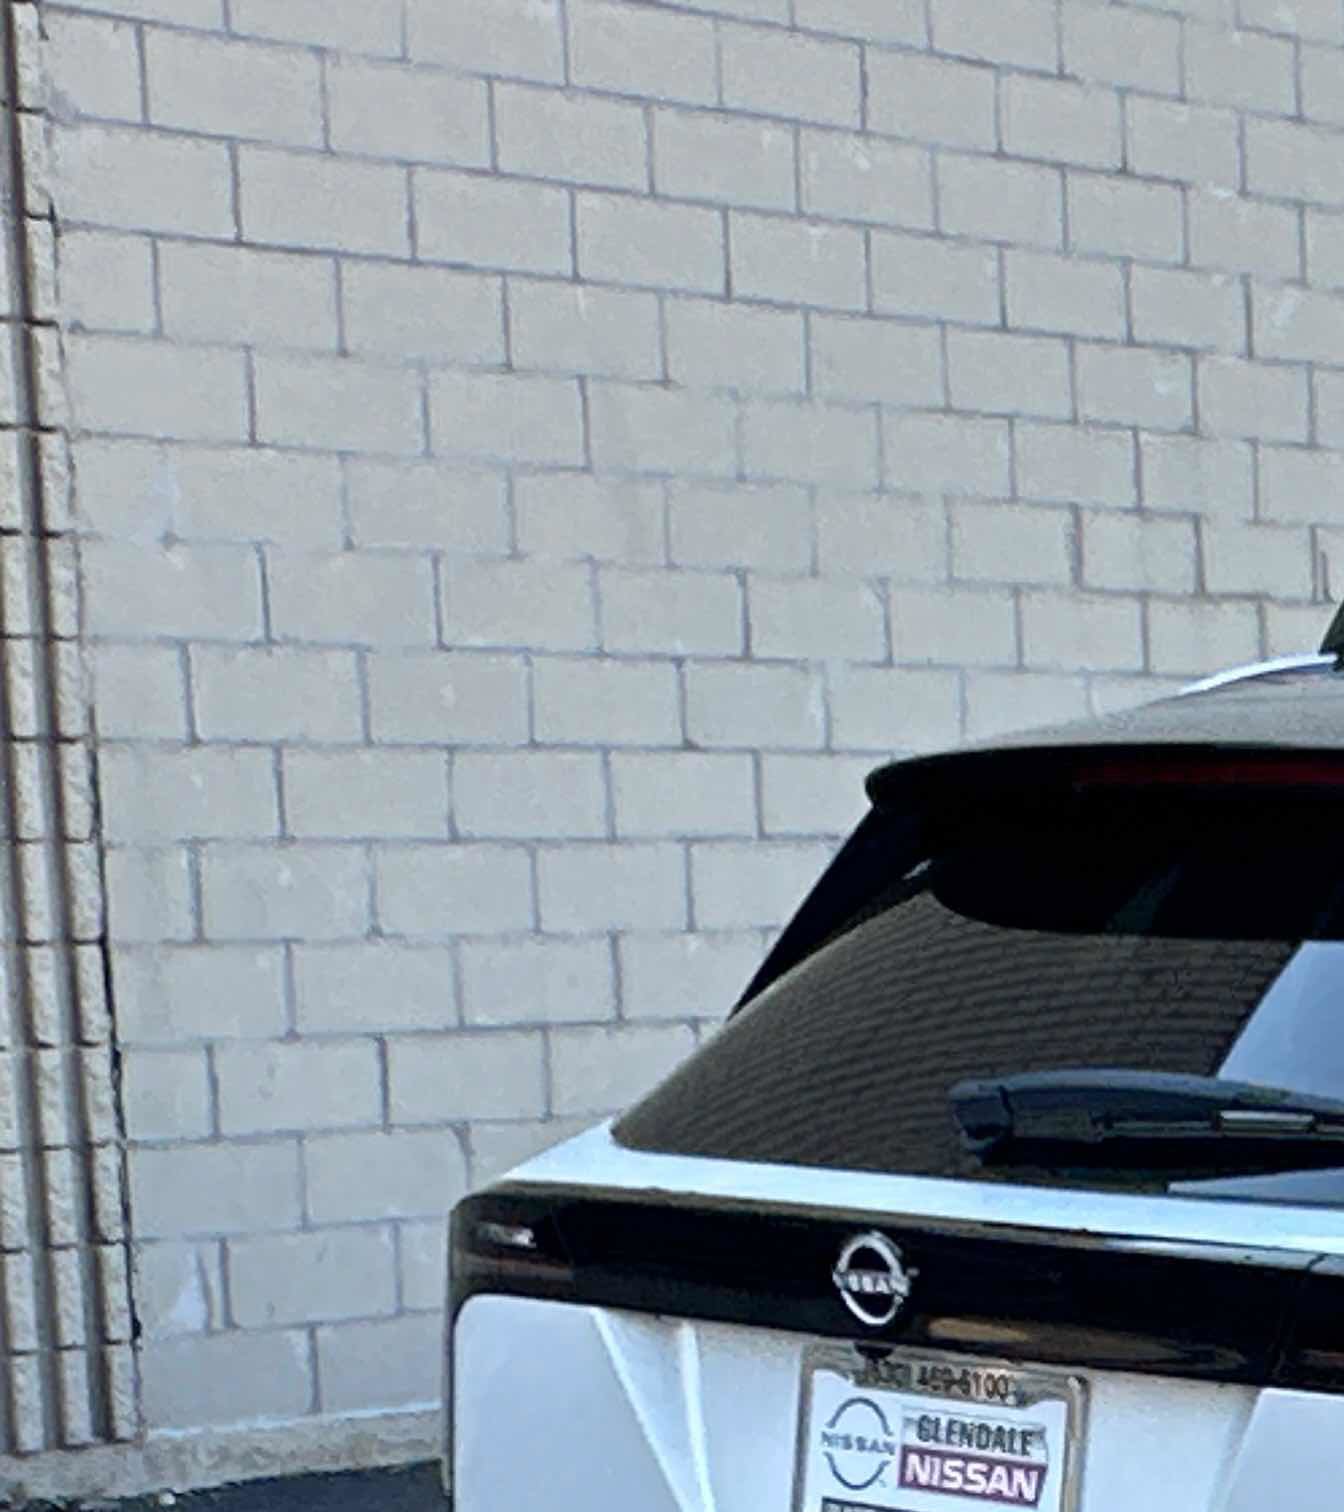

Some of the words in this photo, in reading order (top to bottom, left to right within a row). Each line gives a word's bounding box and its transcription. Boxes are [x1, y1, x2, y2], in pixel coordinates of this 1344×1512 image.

[820, 1430, 896, 1457] NISSAN
[916, 1414, 1034, 1456] GLENDALE
[904, 1452, 1040, 1502] NISSAN
